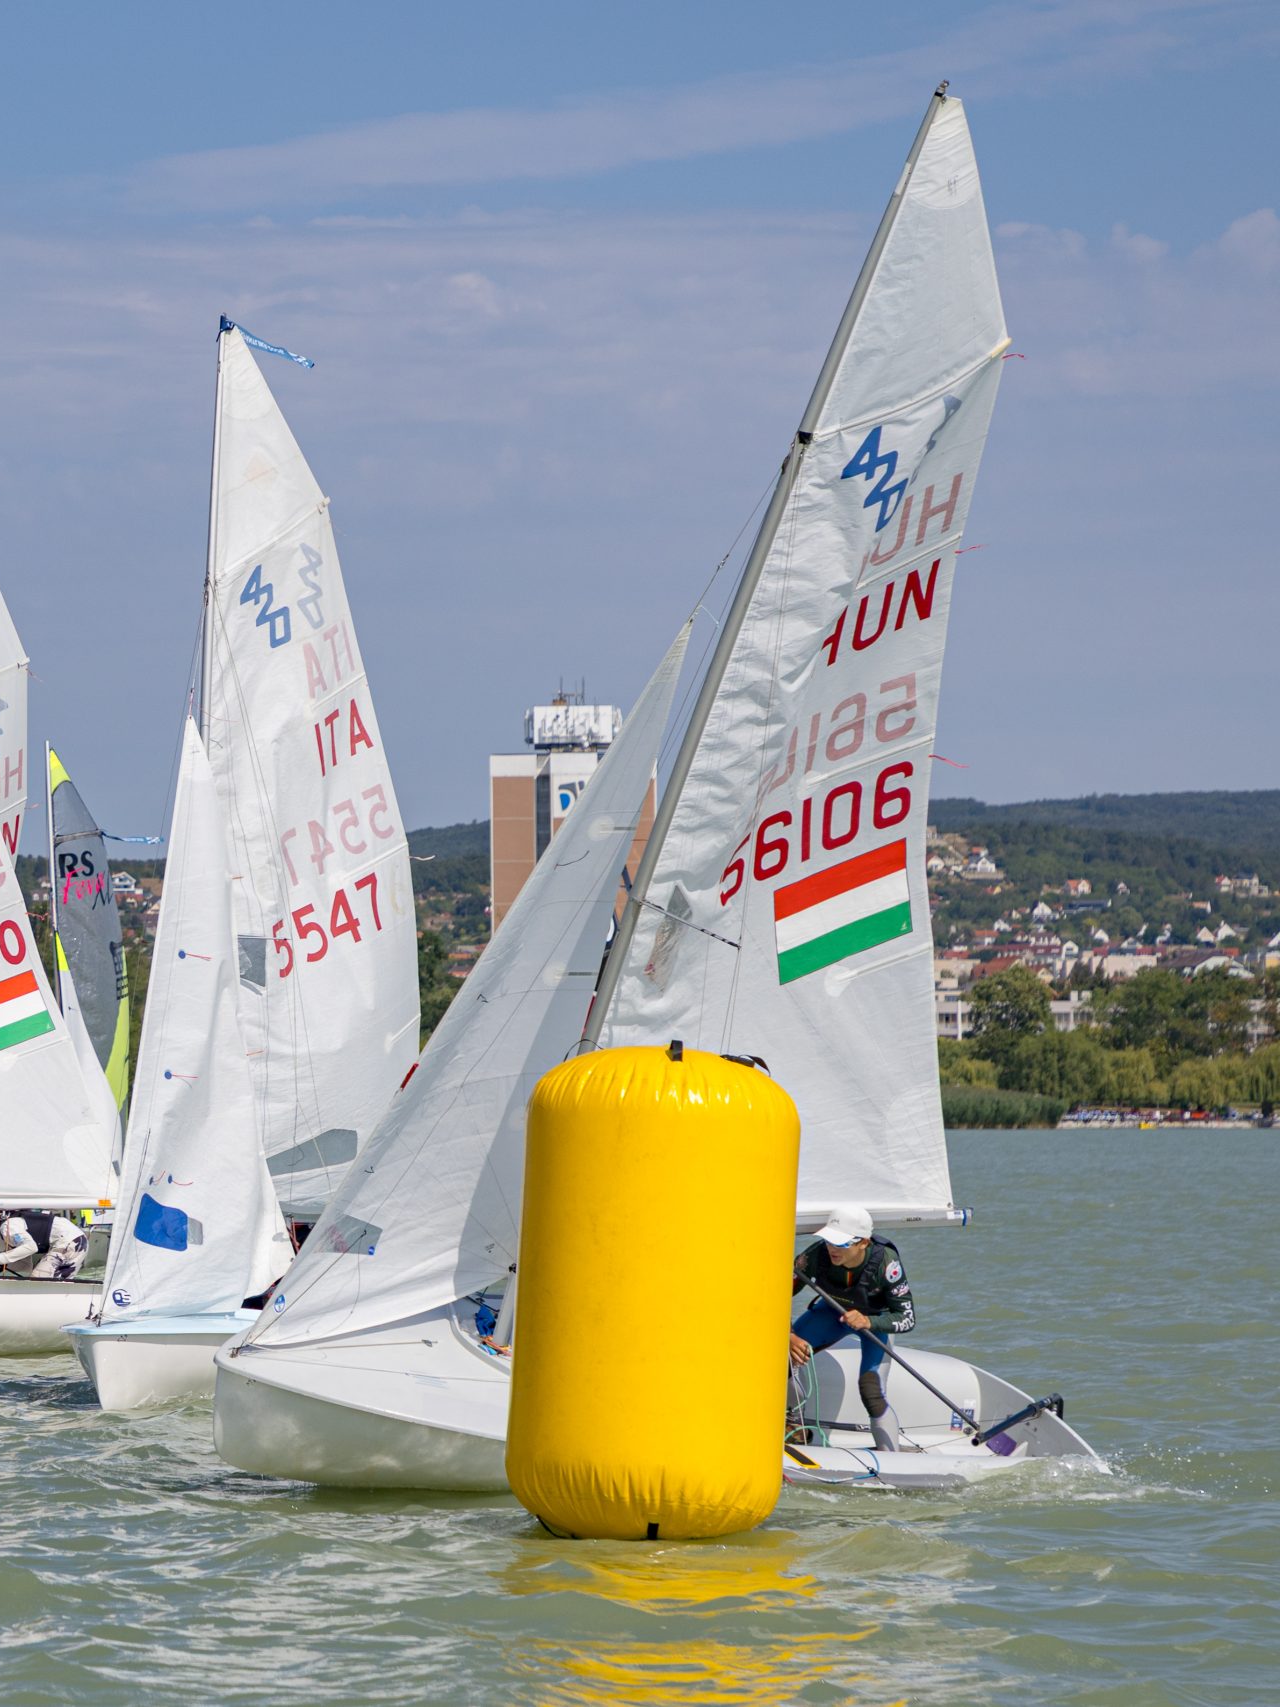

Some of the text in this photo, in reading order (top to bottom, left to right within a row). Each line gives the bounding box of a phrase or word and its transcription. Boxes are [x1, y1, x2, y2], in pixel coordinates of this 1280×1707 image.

[841, 425, 909, 533] 420
[240, 563, 292, 649] 420
[314, 697, 374, 778] ITA
[58, 850, 95, 879] RS
[720, 760, 914, 907] 56106
[272, 872, 383, 979] 5547
